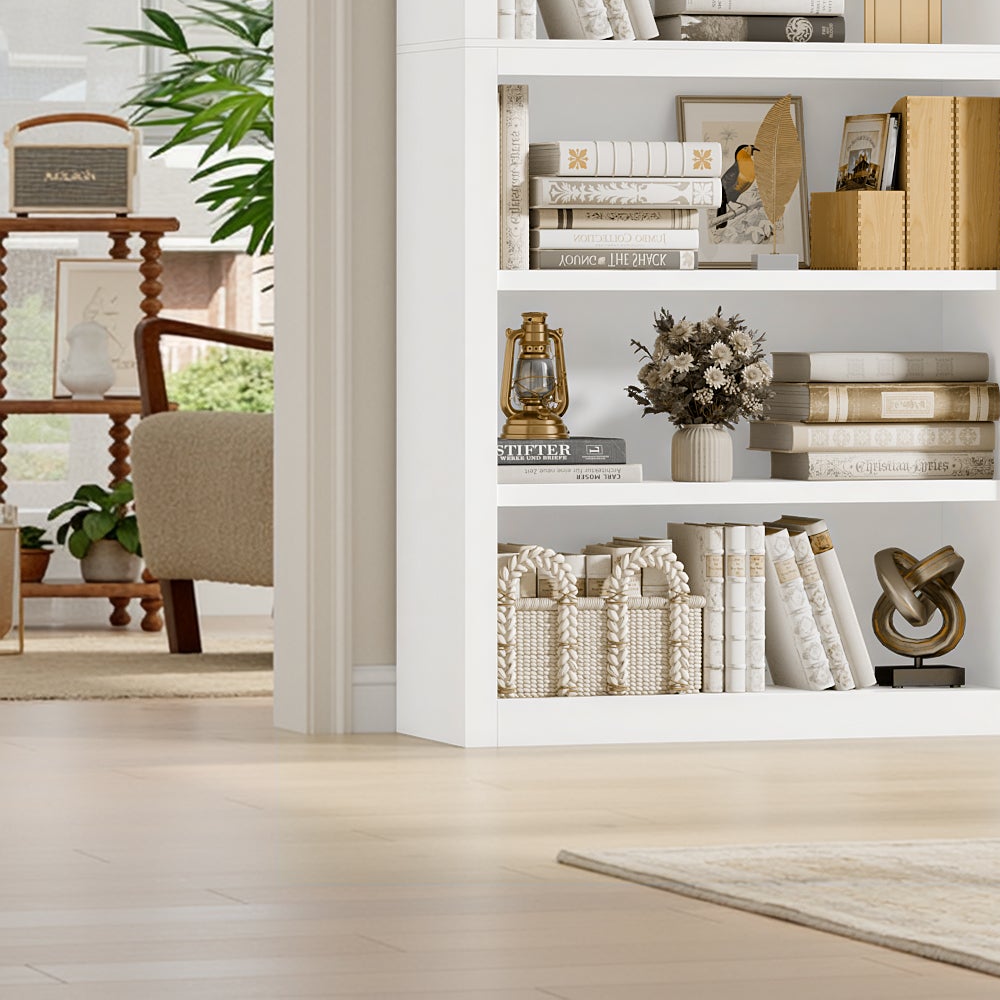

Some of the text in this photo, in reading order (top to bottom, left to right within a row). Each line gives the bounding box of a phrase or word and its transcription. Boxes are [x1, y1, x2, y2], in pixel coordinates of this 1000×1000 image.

[497, 444, 572, 456] STIFTER
[524, 467, 538, 475] Zeit
[572, 467, 583, 475] für
